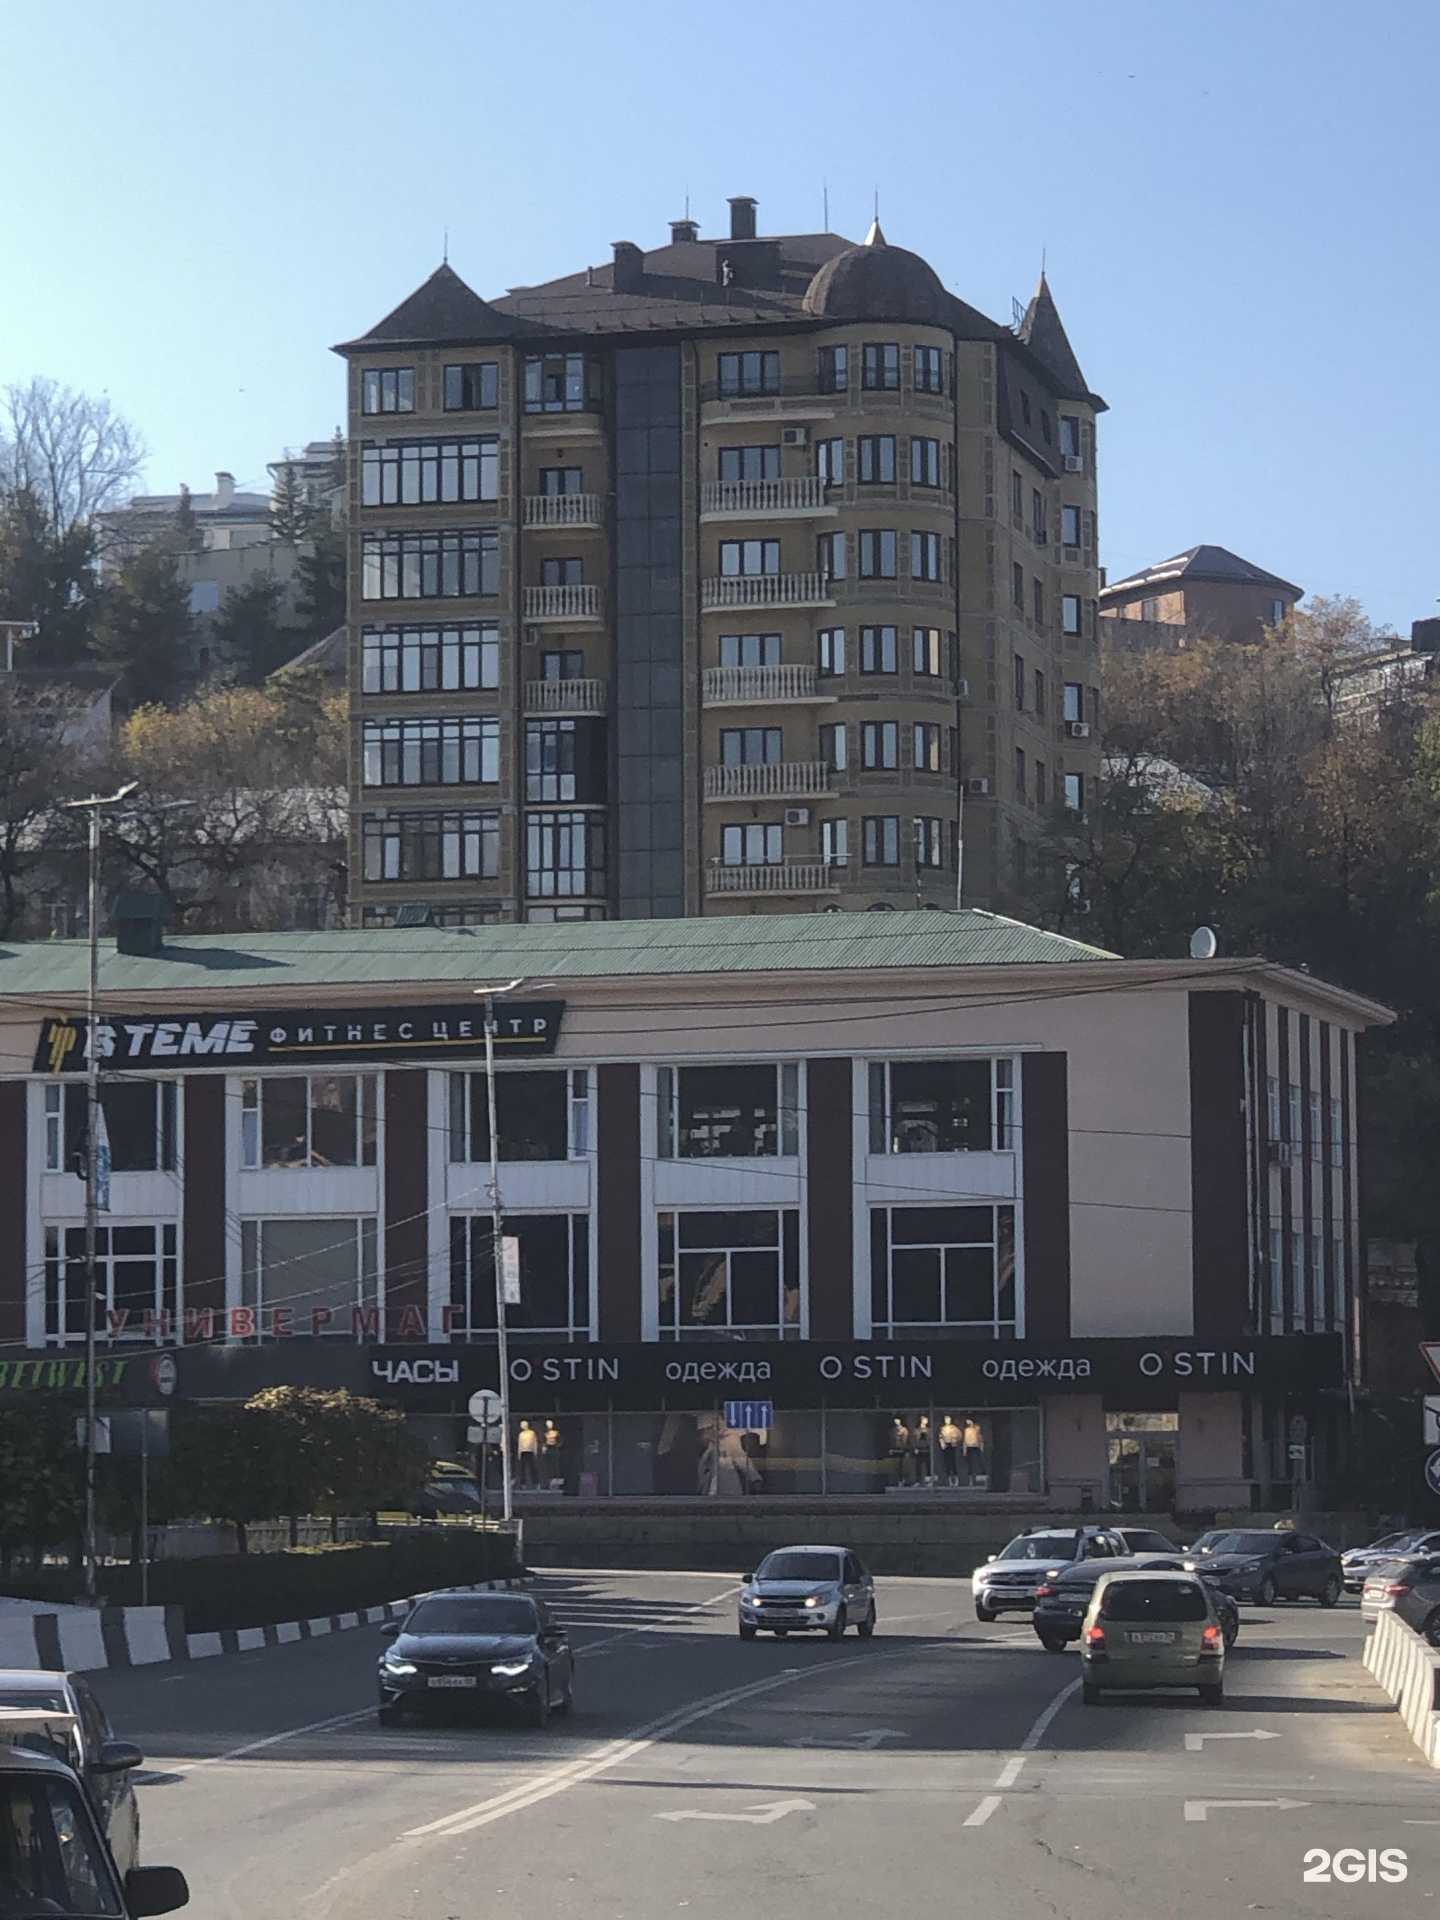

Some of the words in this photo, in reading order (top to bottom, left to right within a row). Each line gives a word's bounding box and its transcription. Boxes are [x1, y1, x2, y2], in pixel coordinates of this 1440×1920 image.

[83, 1025, 117, 1057] В
[124, 1020, 259, 1057] ТЕМЕ
[269, 1023, 413, 1043] ФИТНЕС
[433, 1018, 547, 1040] ЦЕНТР
[106, 1304, 464, 1338] УНИВЕРМАГ
[372, 1359, 459, 1383] ЧАСЫ
[665, 1361, 772, 1383] одежда
[982, 1358, 1092, 1381] одежда
